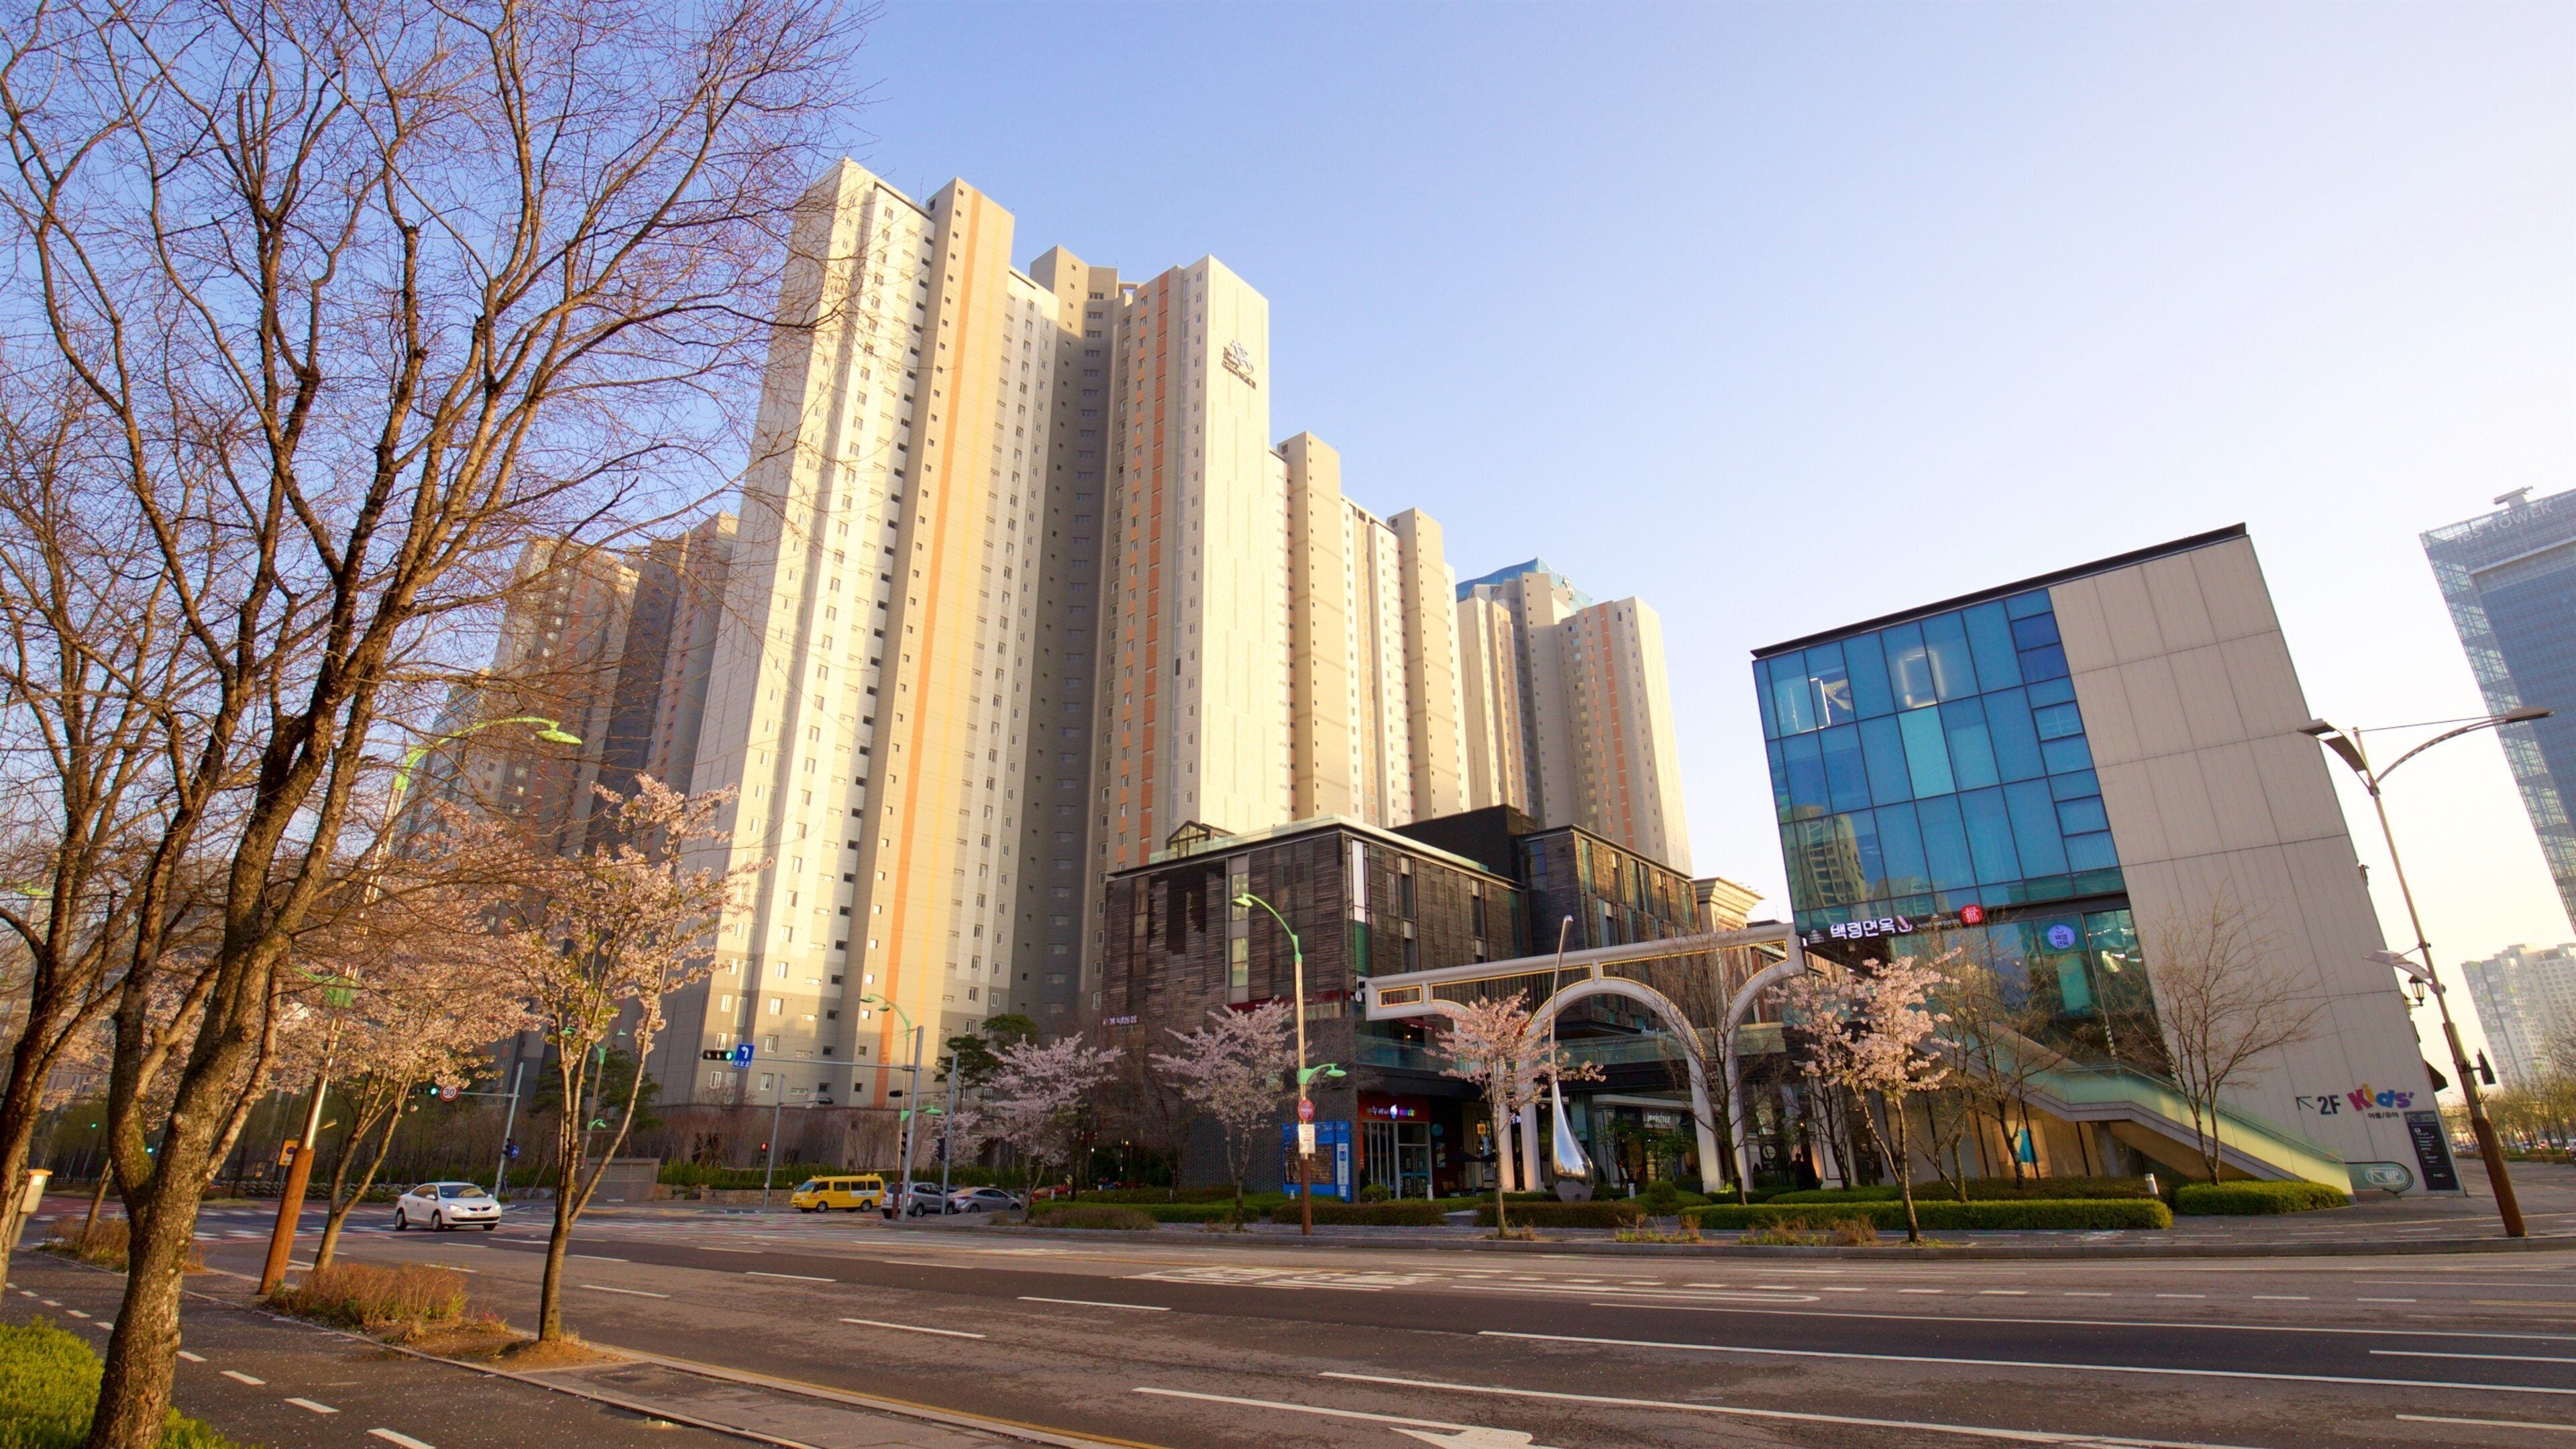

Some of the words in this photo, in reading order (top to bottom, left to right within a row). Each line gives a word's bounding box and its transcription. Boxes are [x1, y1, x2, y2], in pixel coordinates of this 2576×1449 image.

[2490, 500, 2553, 532] TOWER
[1830, 917, 1896, 940] 백령면옥
[444, 1088, 455, 1096] 30
[2317, 1095, 2341, 1115] 2F
[2386, 1170, 2399, 1180] UP
